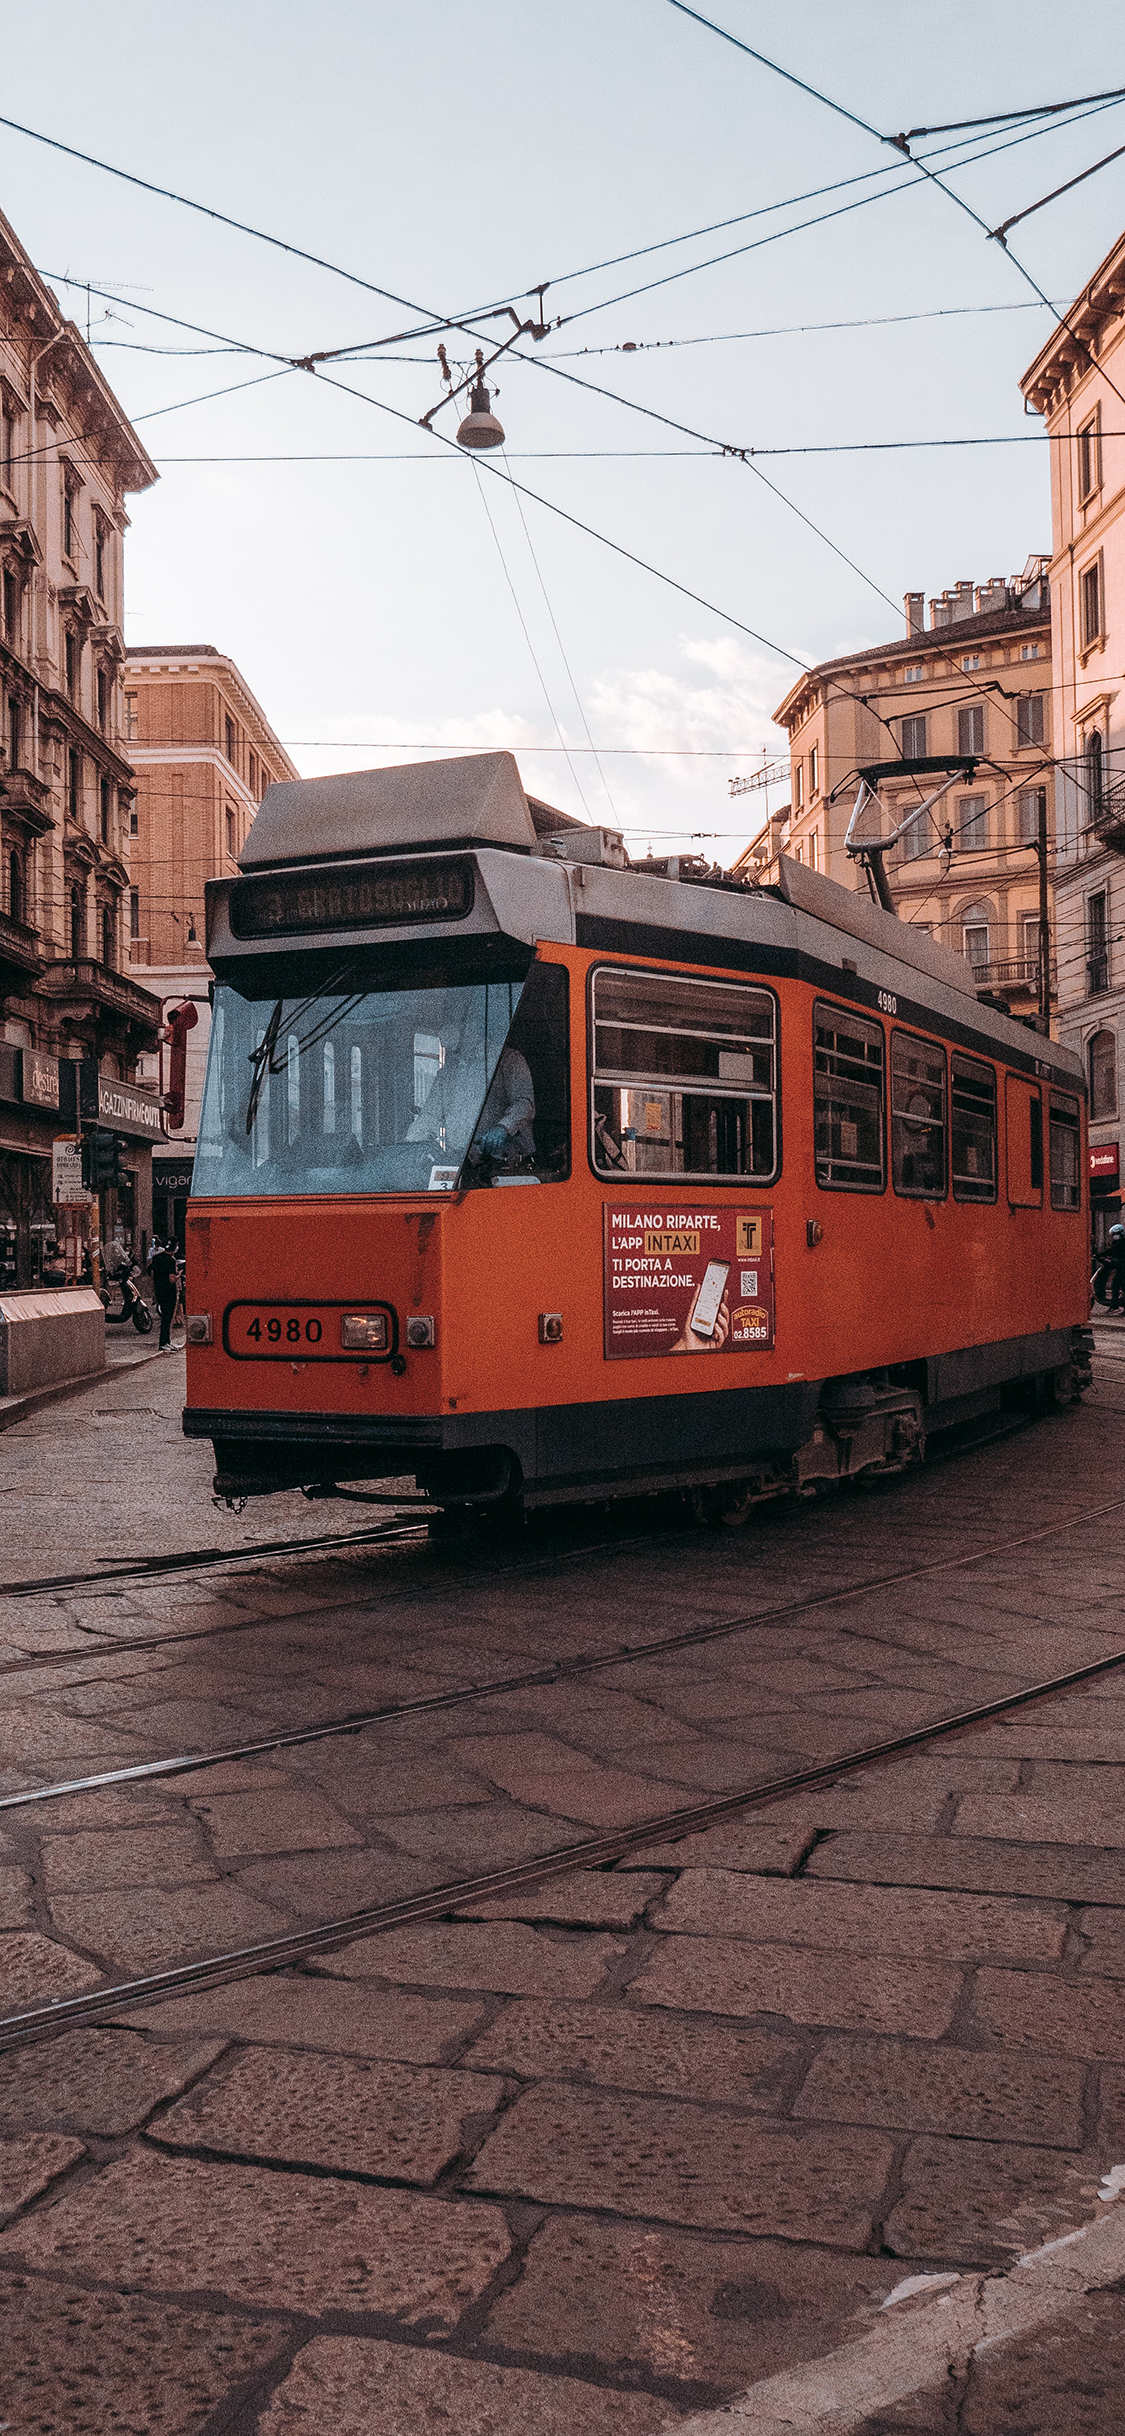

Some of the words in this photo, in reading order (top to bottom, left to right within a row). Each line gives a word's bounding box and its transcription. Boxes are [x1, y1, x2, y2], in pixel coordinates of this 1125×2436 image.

[877, 990, 897, 1015] 4980
[612, 1214, 663, 1229] MILANO
[666, 1215, 721, 1231] RIPARTE,
[612, 1236, 643, 1250] L'APP
[647, 1234, 698, 1252] INTAXI
[612, 1259, 623, 1271] TI
[625, 1258, 662, 1271] PORTA
[663, 1258, 673, 1271] A
[612, 1274, 696, 1289] DESTINAZIONE.
[733, 1308, 766, 1320] autoradio
[740, 1317, 760, 1327] TAXI
[246, 1318, 323, 1343] 4980
[733, 1326, 767, 1339] 02.8585
